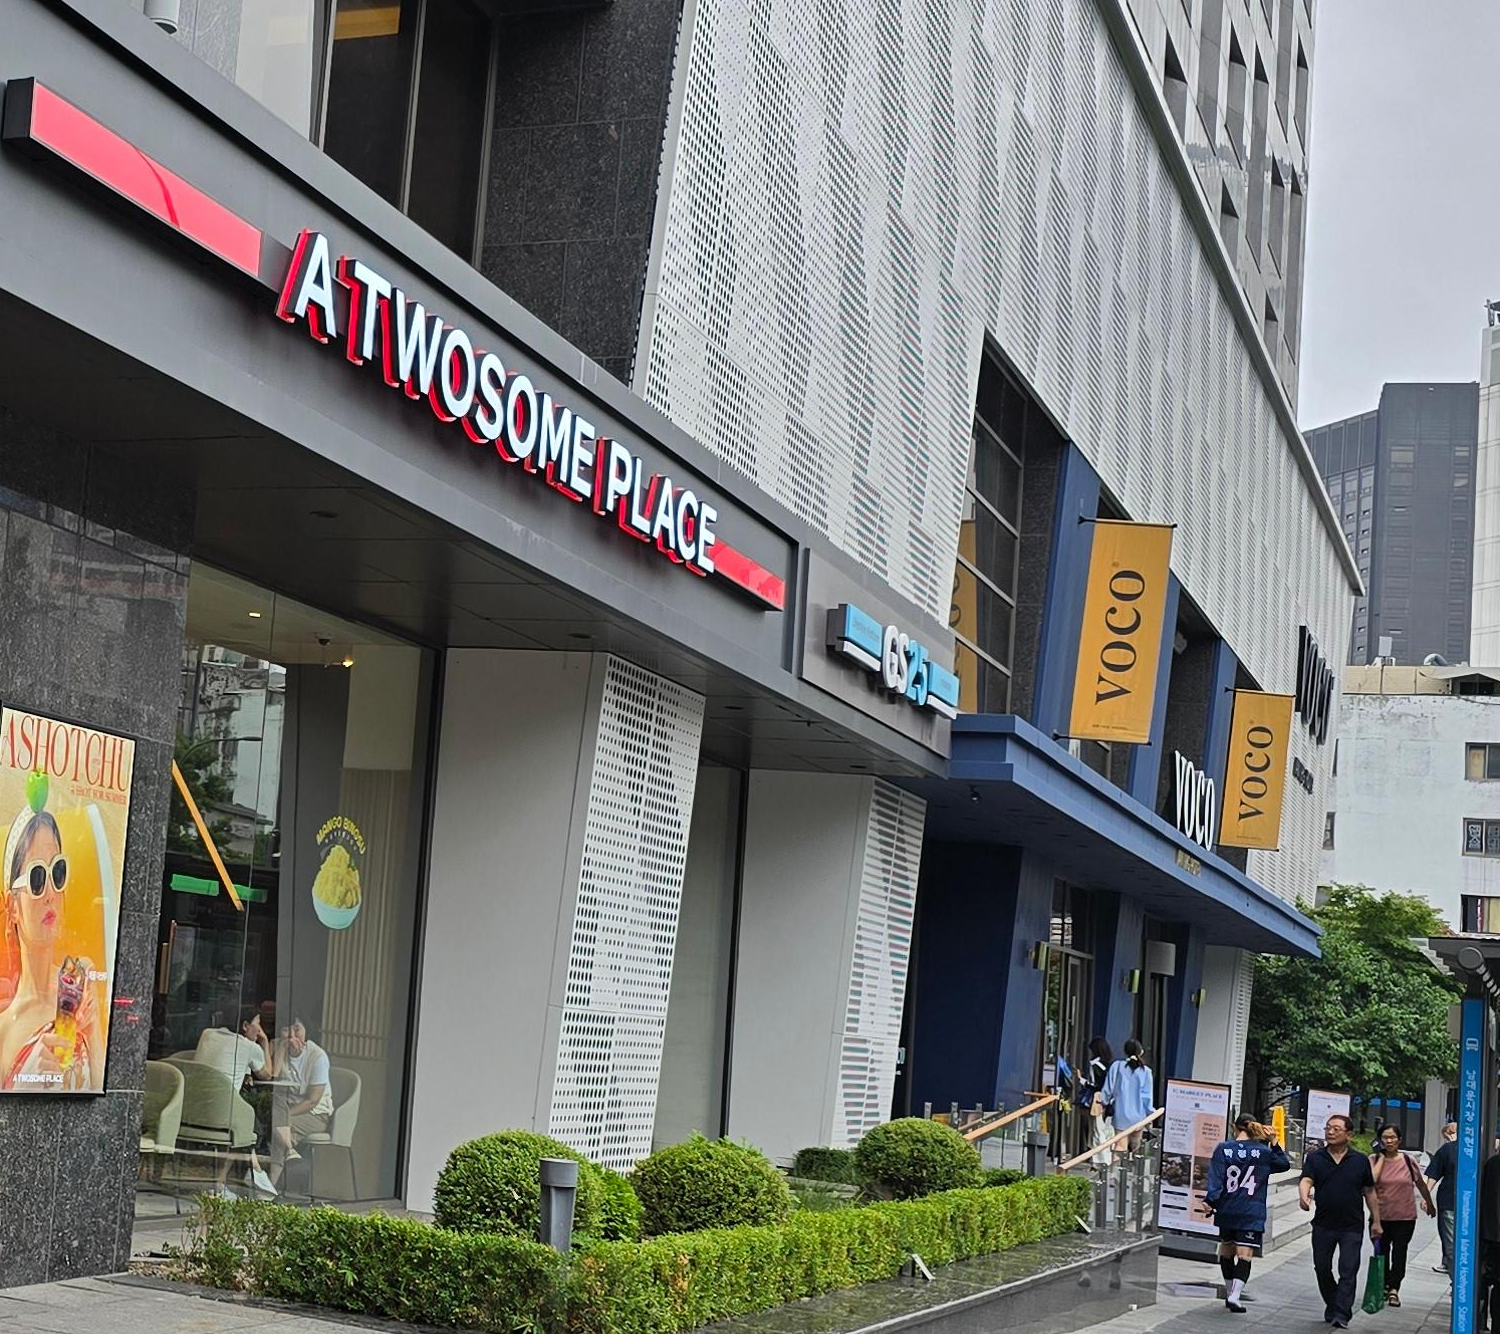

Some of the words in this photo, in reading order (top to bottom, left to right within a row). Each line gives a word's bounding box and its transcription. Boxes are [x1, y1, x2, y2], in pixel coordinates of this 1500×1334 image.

[284, 230, 337, 340] A
[344, 257, 597, 500] TWOSOME
[601, 439, 719, 575] PLACE
[883, 625, 928, 706] GS25
[0, 712, 134, 792] ASHOTCHU
[1226, 1165, 1257, 1196] 84
